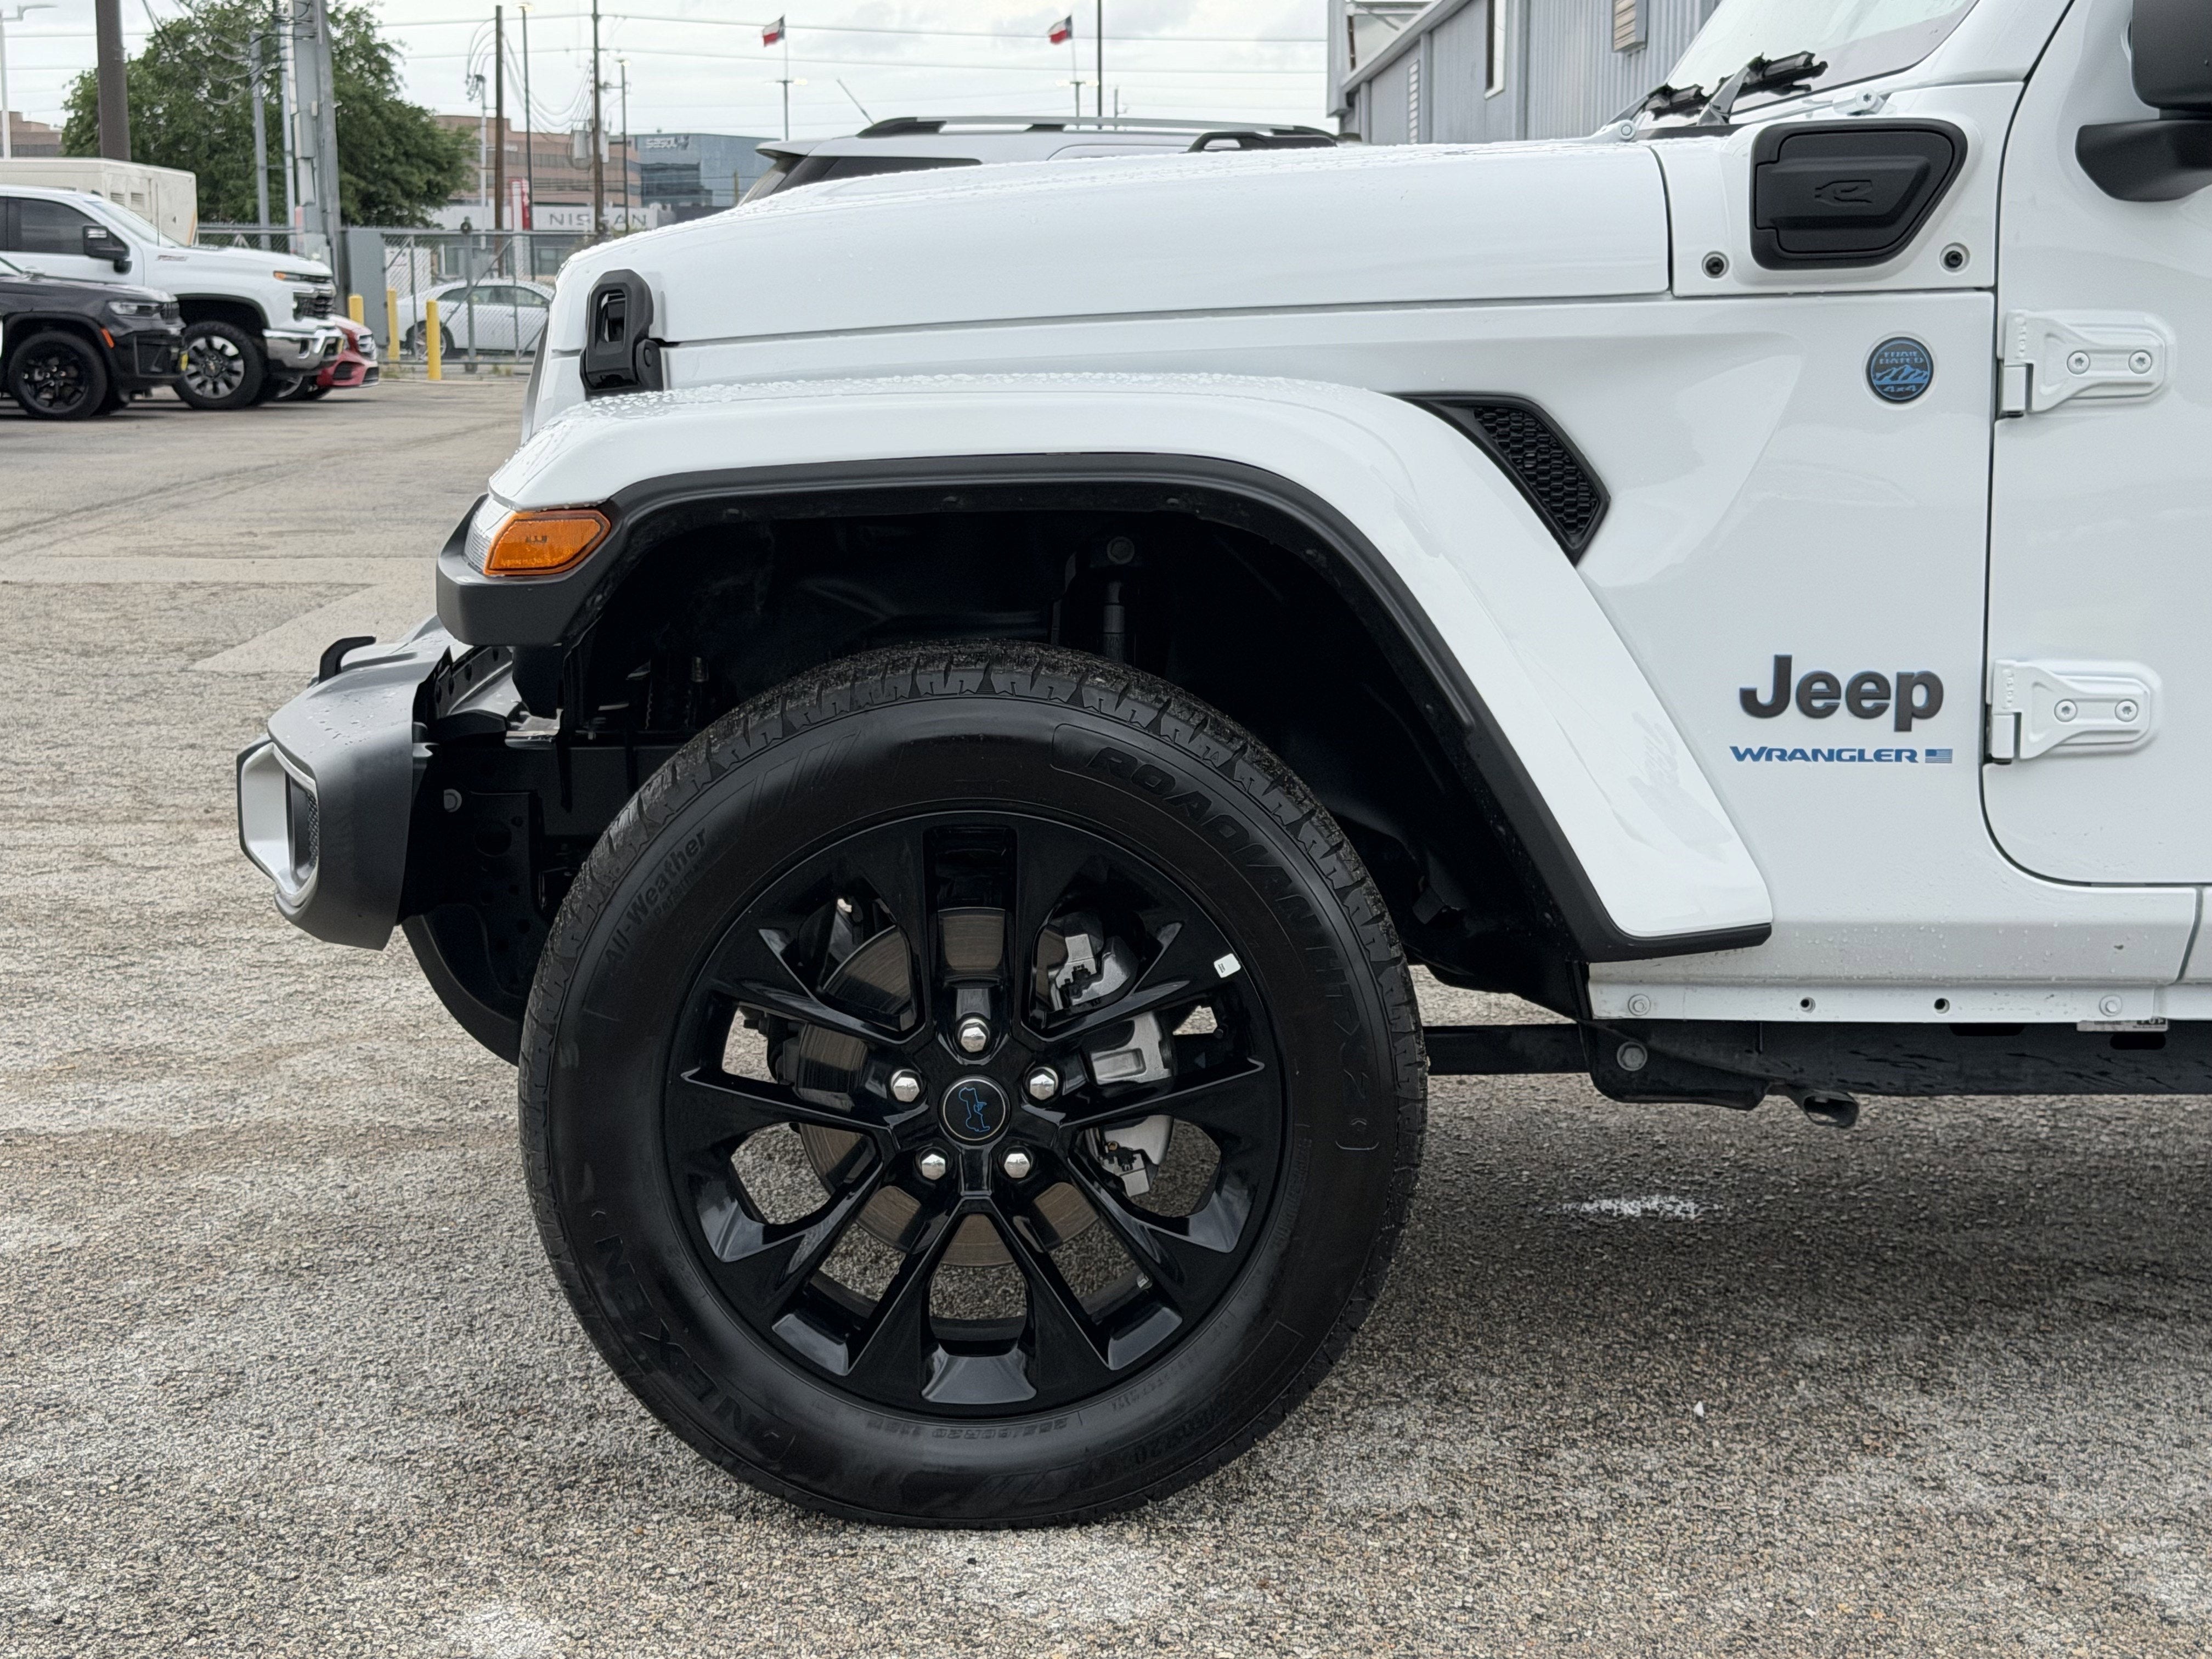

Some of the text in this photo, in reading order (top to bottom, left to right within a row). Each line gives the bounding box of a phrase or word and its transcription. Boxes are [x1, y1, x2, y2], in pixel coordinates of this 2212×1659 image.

[1729, 746, 1919, 763] WRANGLER
[1739, 654, 1944, 732] Jeep
[605, 828, 707, 962] All-Weather
[1085, 746, 1321, 927] ROADIAN
[594, 1232, 753, 1436] NEXEN
